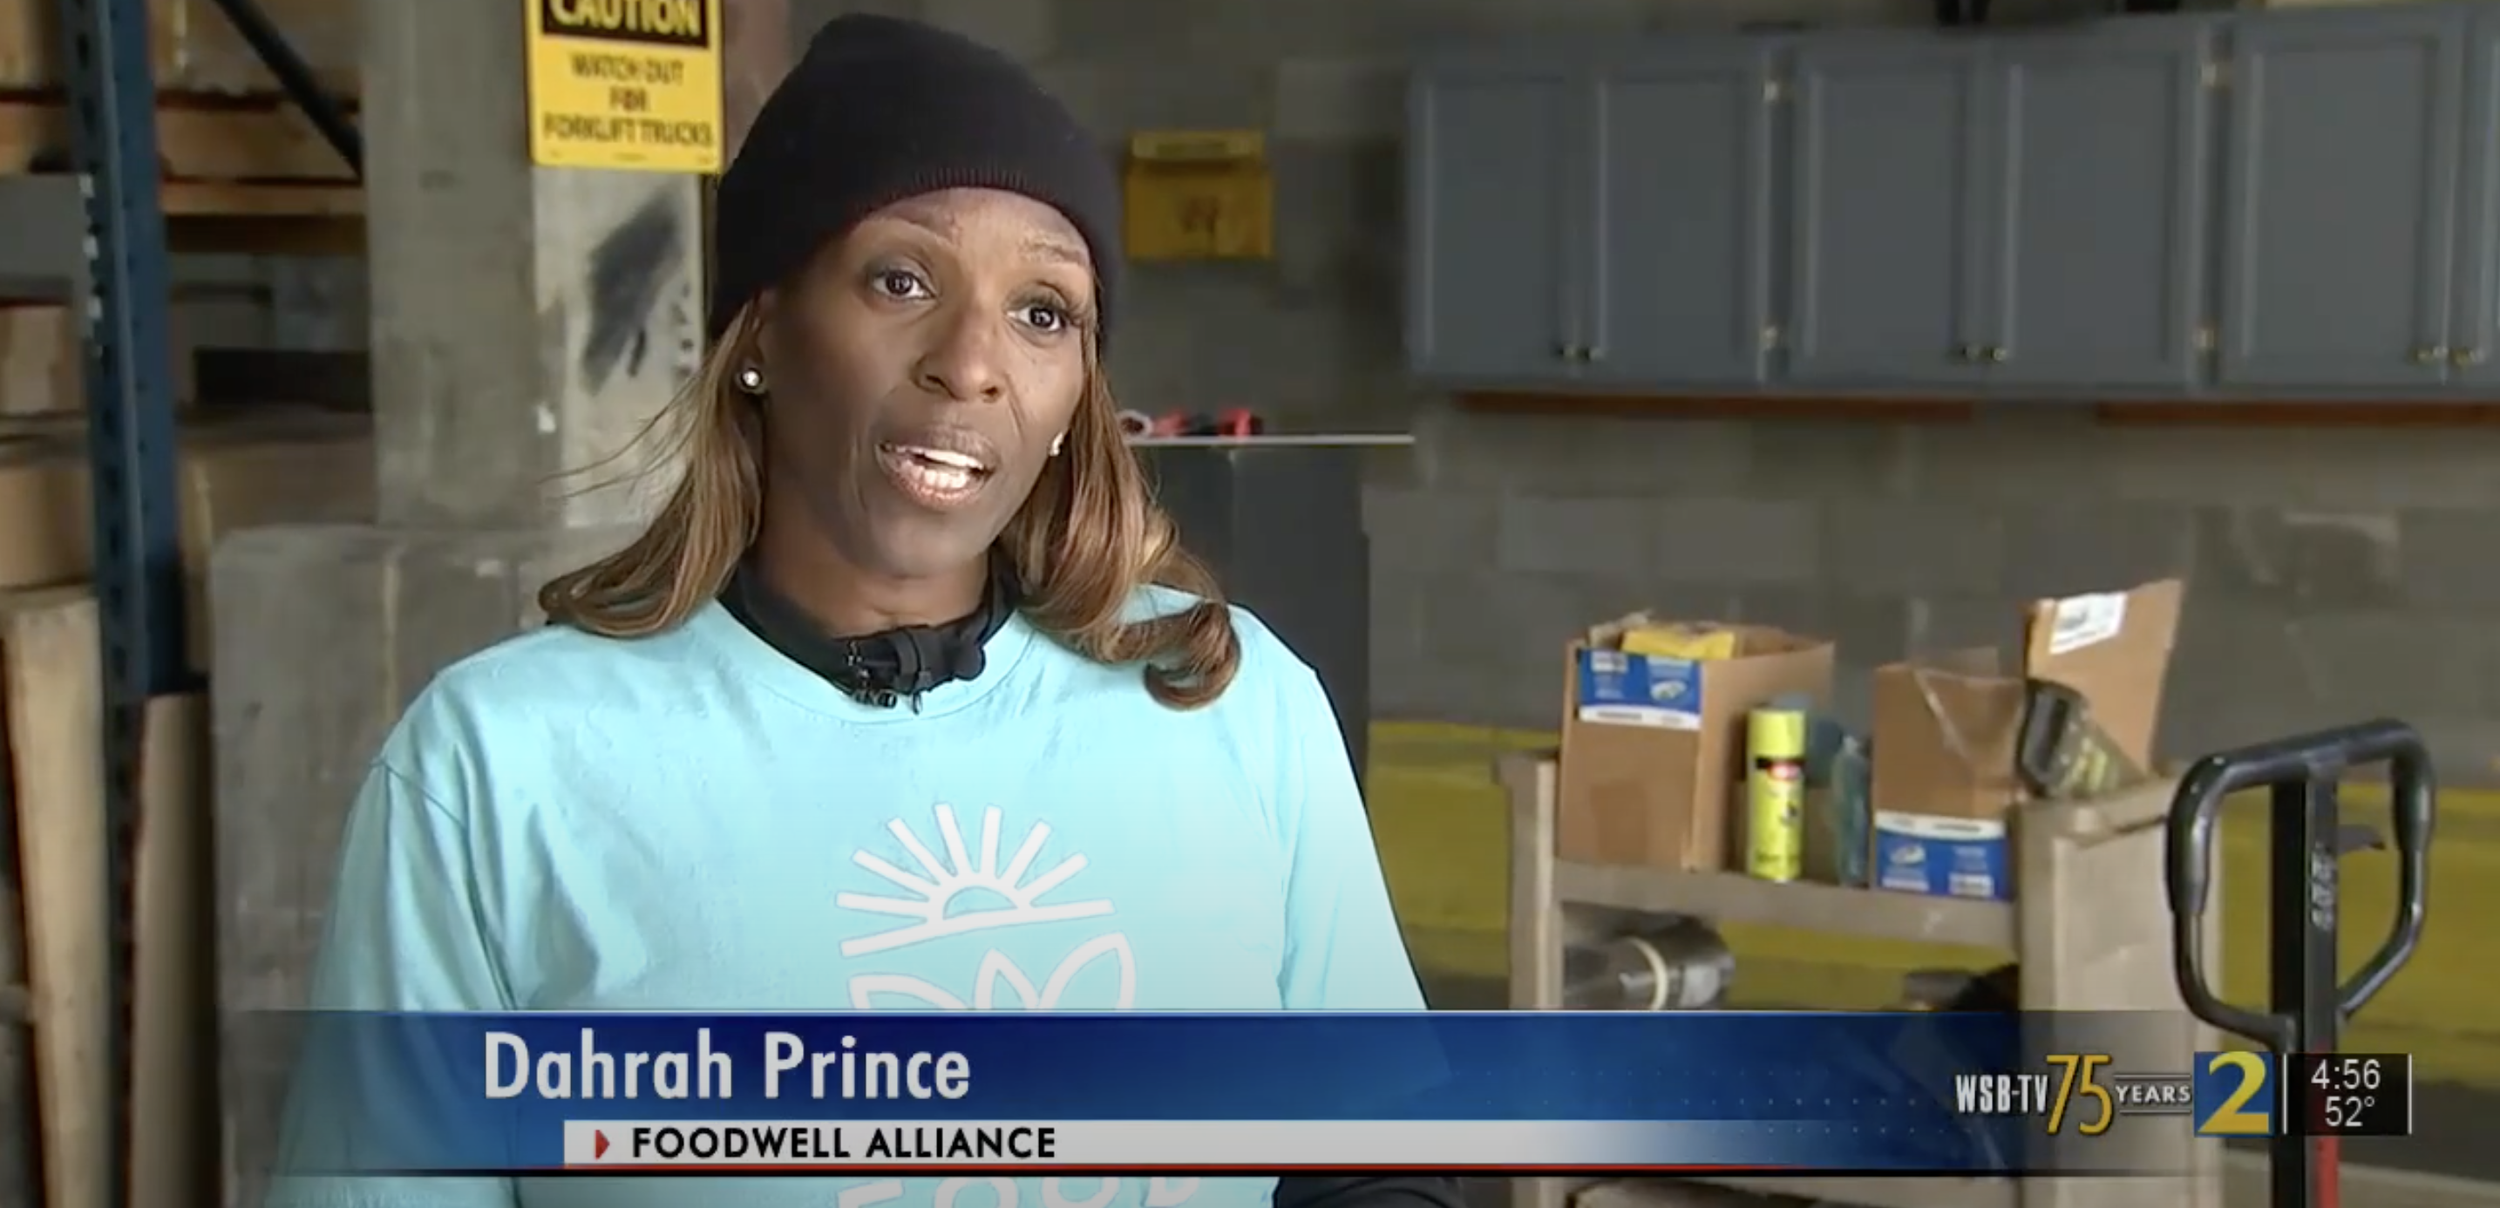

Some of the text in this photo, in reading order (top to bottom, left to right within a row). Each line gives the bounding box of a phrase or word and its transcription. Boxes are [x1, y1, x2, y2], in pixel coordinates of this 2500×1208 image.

[549, 0, 701, 37] CAUTION
[571, 52, 684, 85] WATCH OUT
[609, 86, 648, 112] FOR
[543, 113, 635, 143] FORKLIFT
